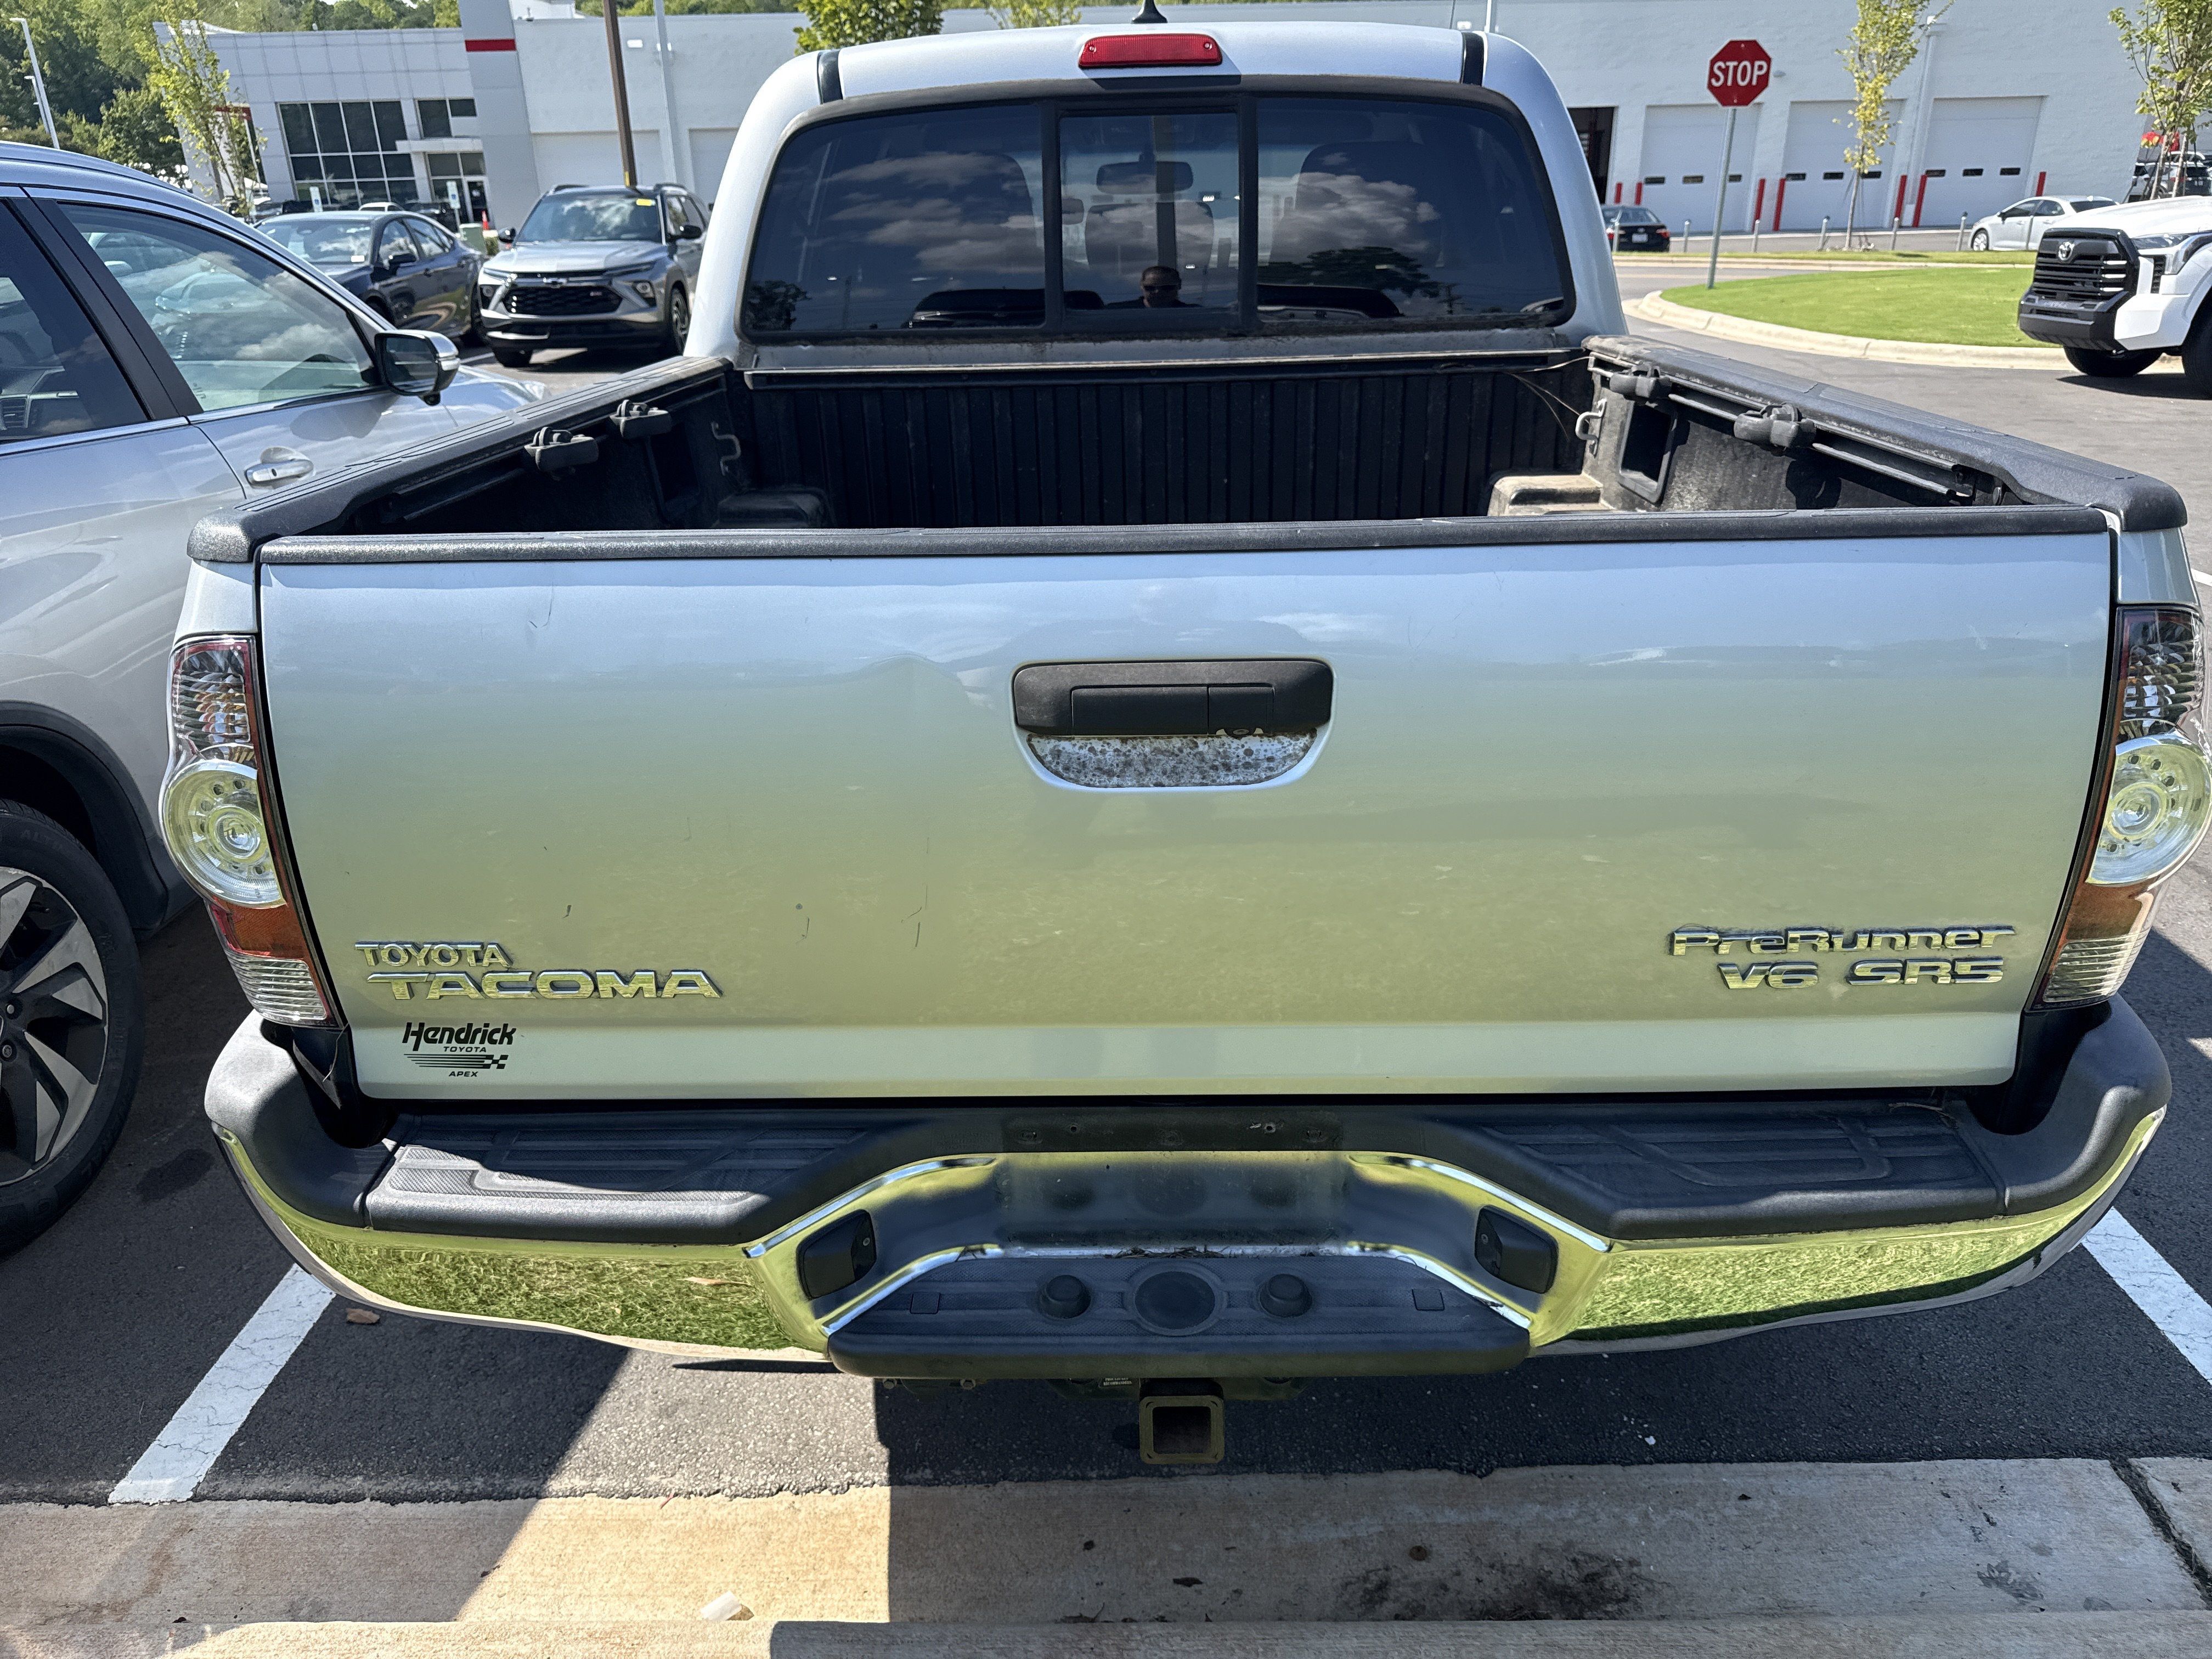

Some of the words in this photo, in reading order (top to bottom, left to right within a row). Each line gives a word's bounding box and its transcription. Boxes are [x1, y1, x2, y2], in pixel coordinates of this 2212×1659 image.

[1711, 60, 1768, 87] STOP
[355, 941, 513, 967] TOYOTA
[1672, 926, 2016, 956] PreRunner
[366, 970, 723, 1000] TACOMA
[1718, 961, 1819, 989] V6
[1846, 958, 2004, 985] SR5
[402, 1022, 517, 1052] Hendrick
